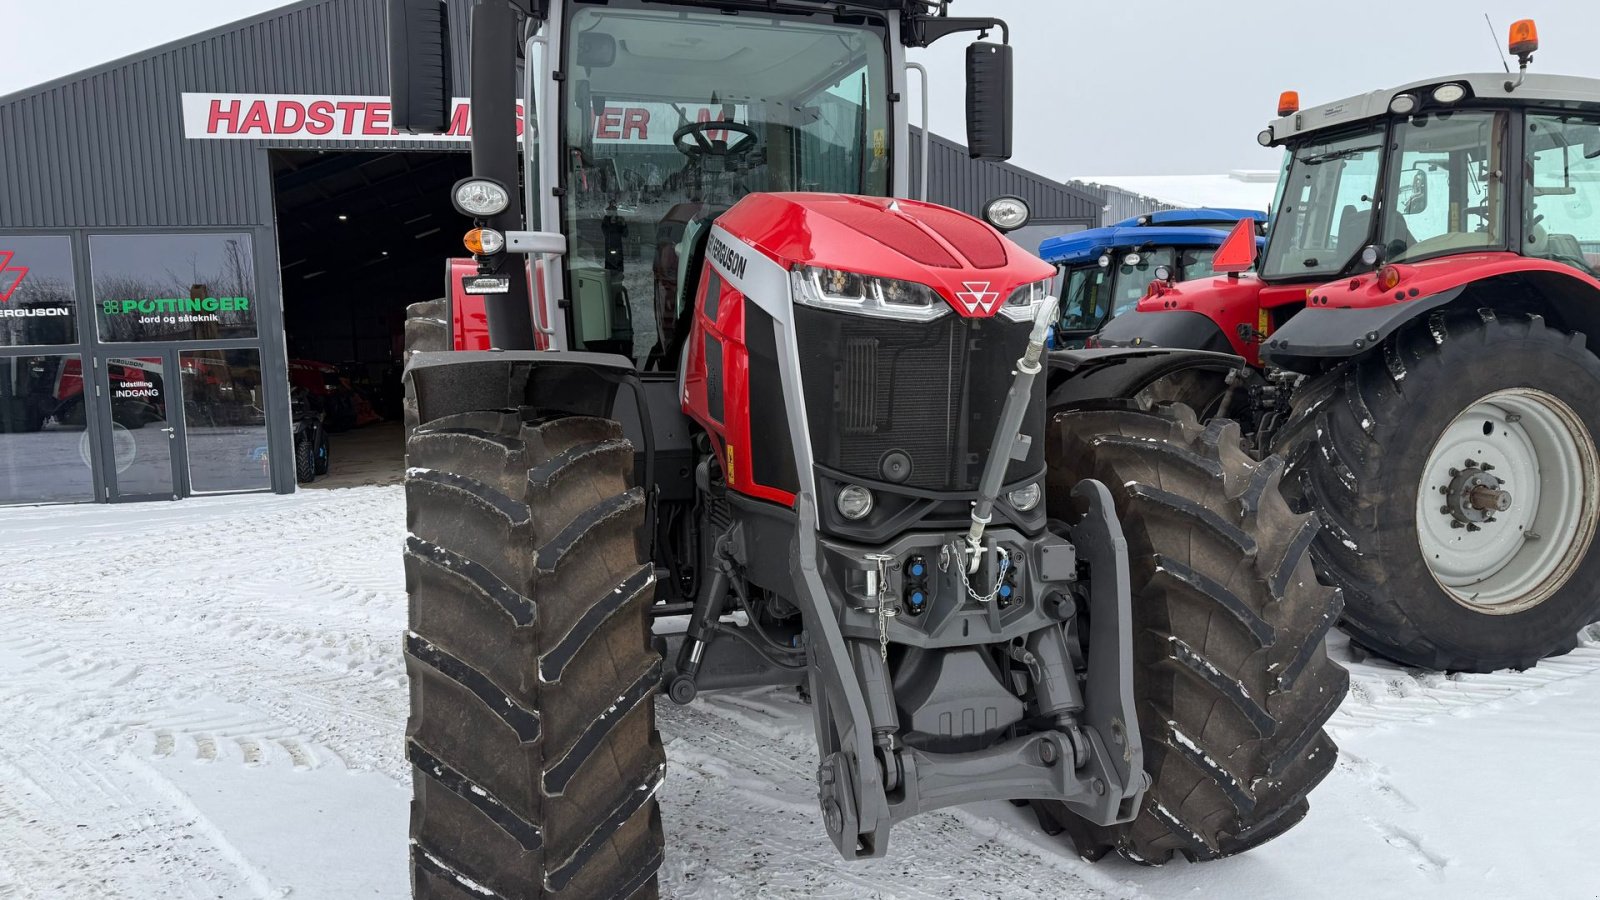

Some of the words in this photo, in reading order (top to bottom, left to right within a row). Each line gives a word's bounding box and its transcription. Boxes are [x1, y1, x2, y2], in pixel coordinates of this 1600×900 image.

[206, 99, 400, 136] HADSTE
[138, 316, 161, 324] Jord
[163, 315, 176, 324] og
[178, 314, 219, 322] såteknik
[120, 381, 153, 389] Udstilling
[116, 389, 159, 398] INDGANG
